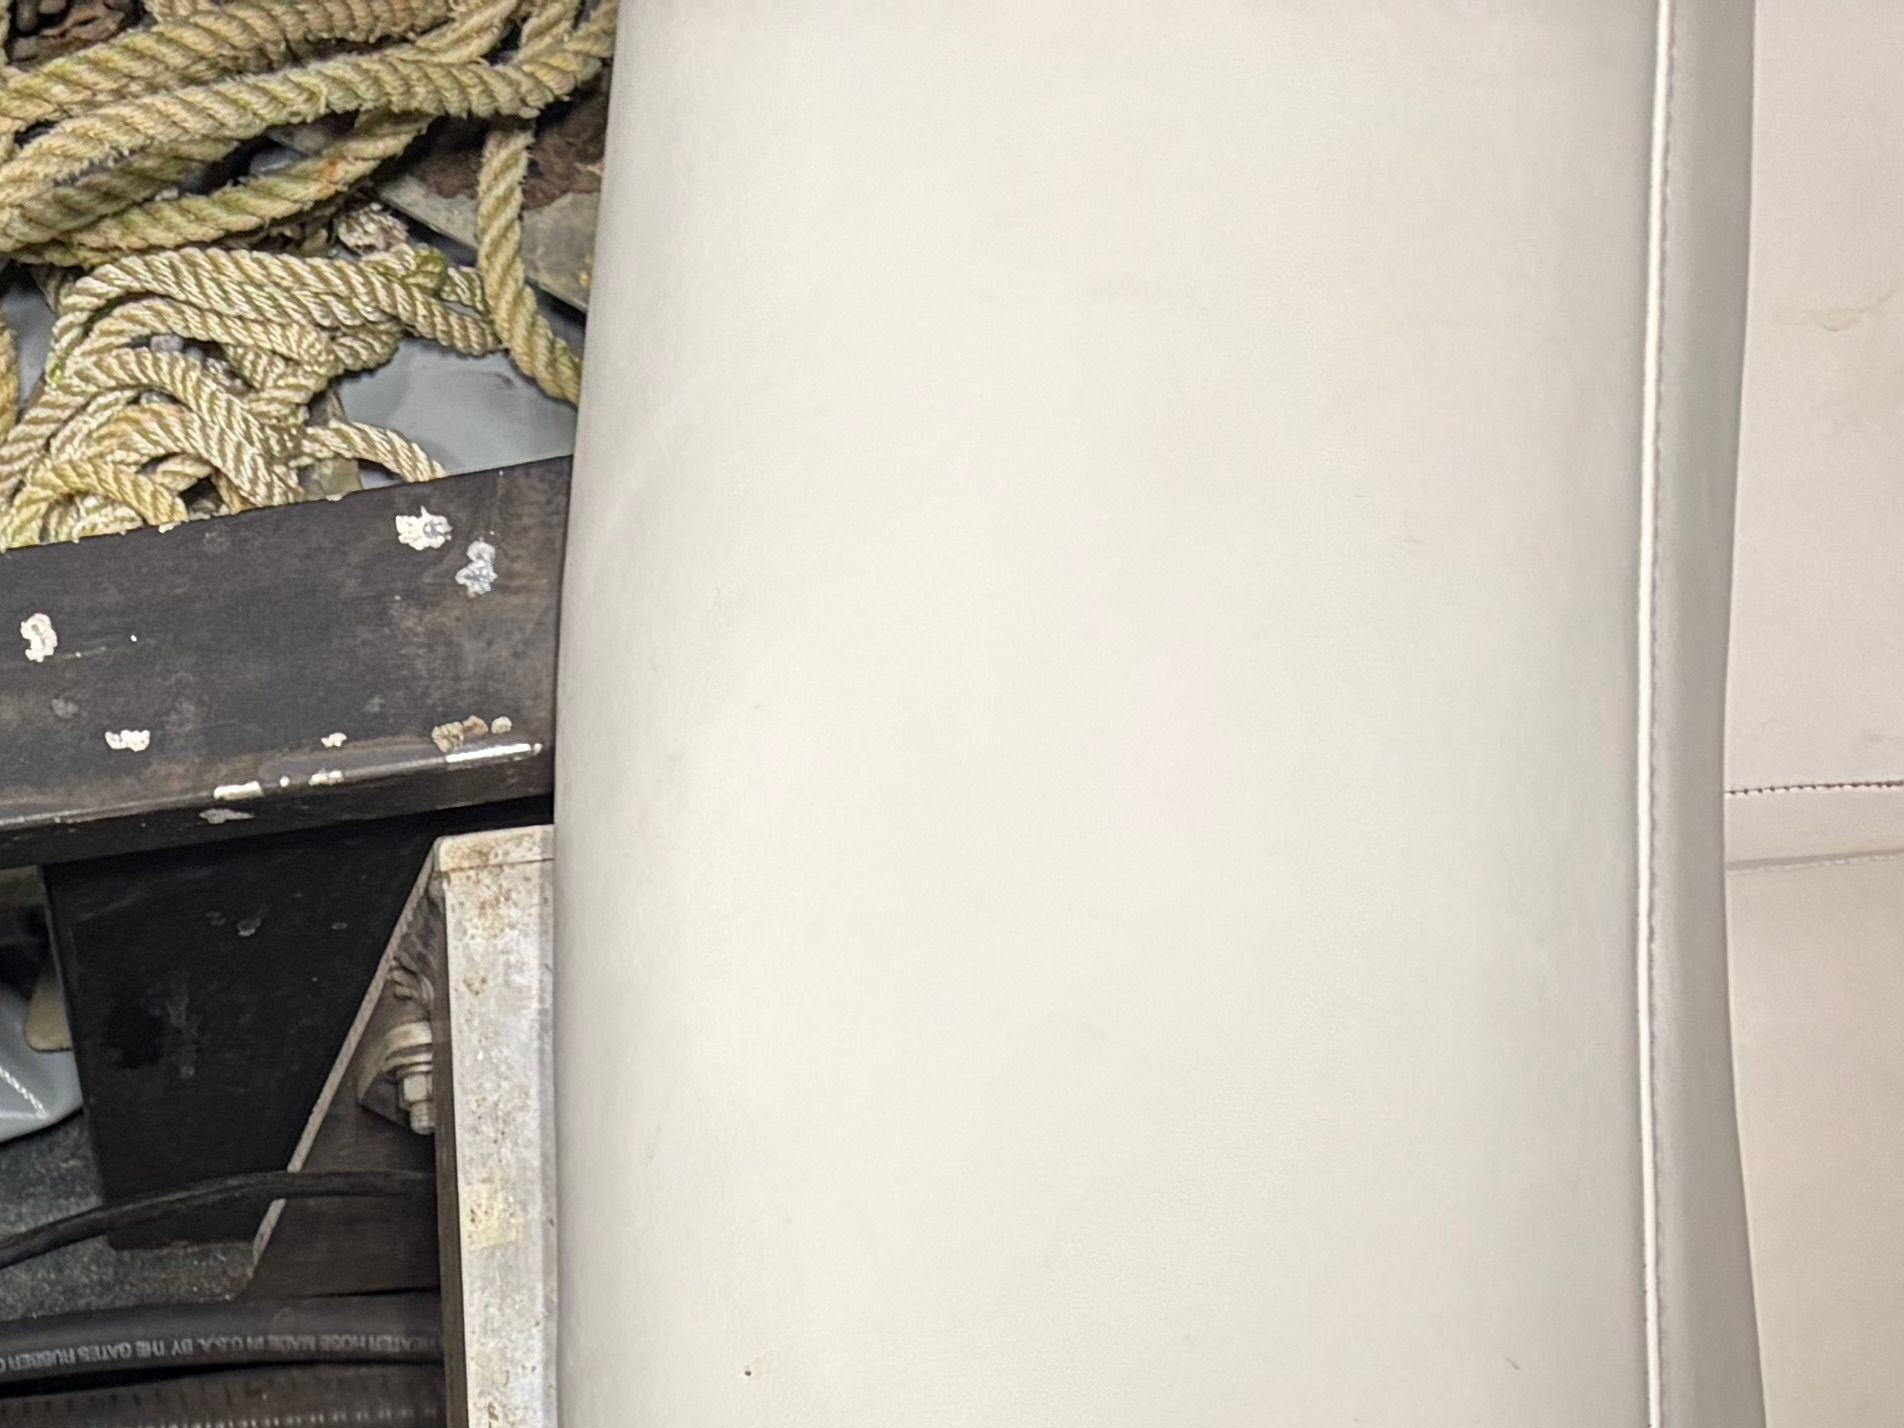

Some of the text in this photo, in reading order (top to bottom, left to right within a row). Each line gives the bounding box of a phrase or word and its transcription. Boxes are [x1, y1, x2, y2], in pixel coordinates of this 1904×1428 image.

[78, 1342, 131, 1363] GATES
[171, 1338, 193, 1356] BY
[7, 1347, 75, 1371] RUBBER
